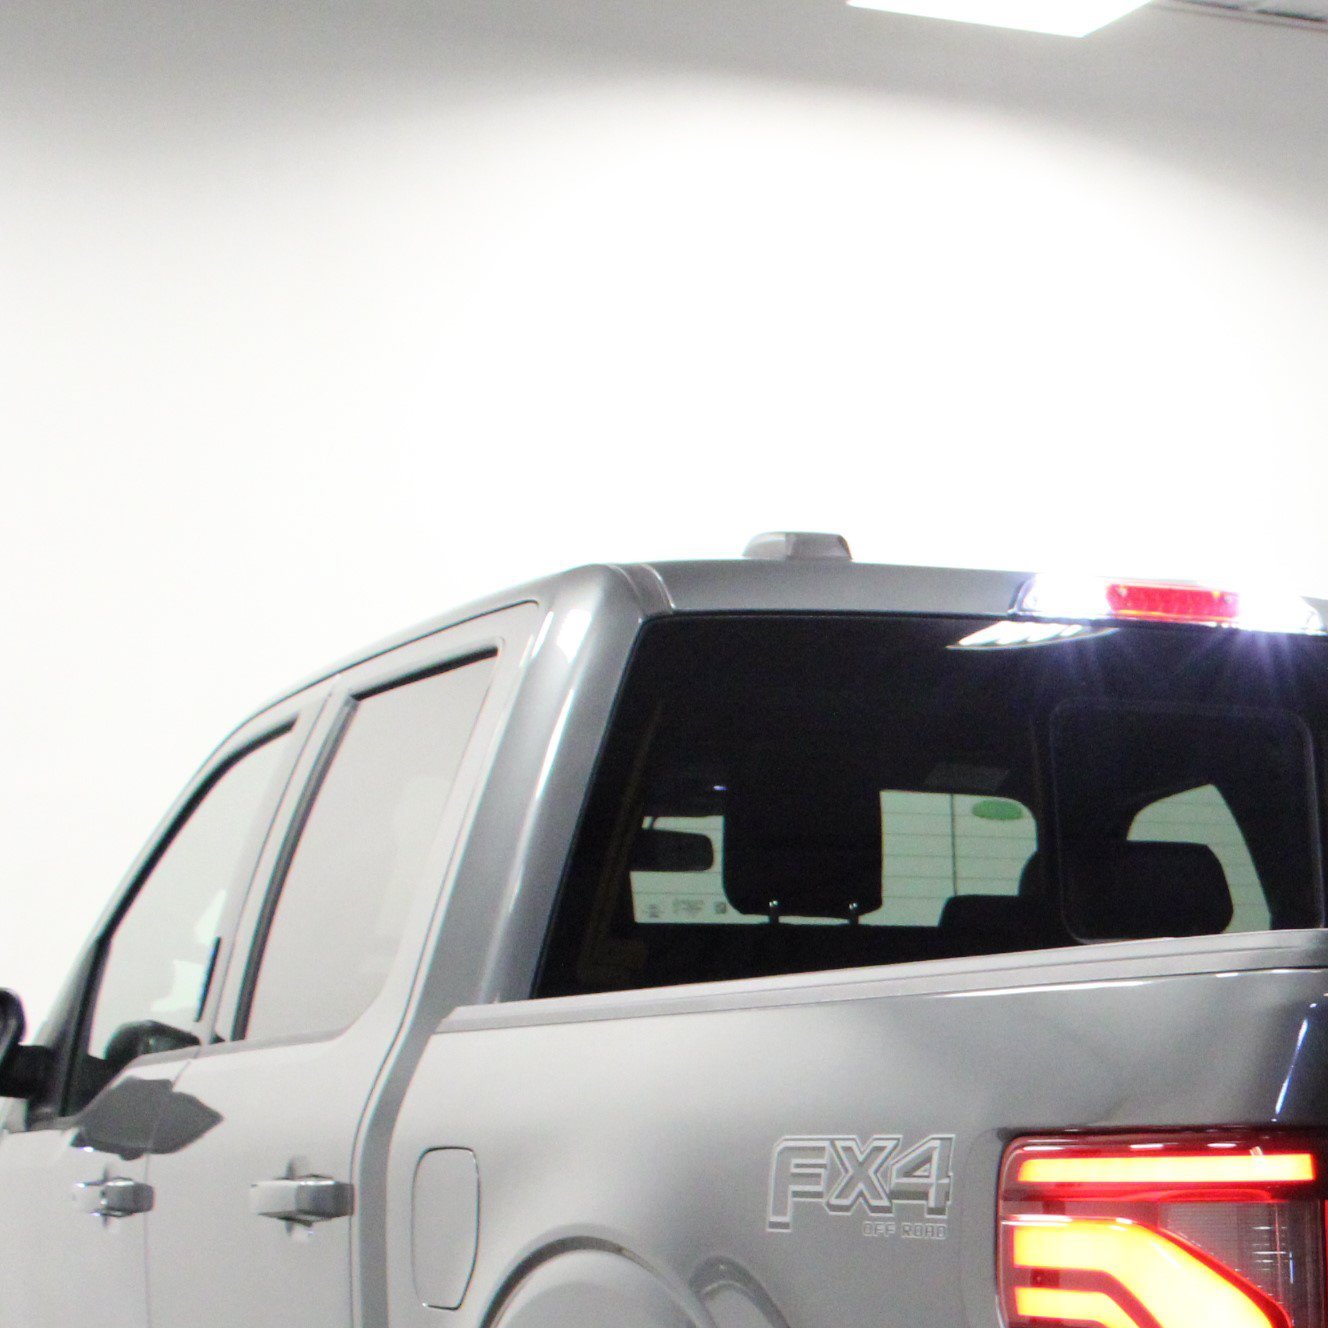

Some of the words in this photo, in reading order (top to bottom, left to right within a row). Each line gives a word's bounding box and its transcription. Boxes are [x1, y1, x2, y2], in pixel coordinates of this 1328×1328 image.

[766, 1134, 956, 1232] FX4
[862, 1220, 896, 1237] OFF
[901, 1222, 948, 1239] ROAD
